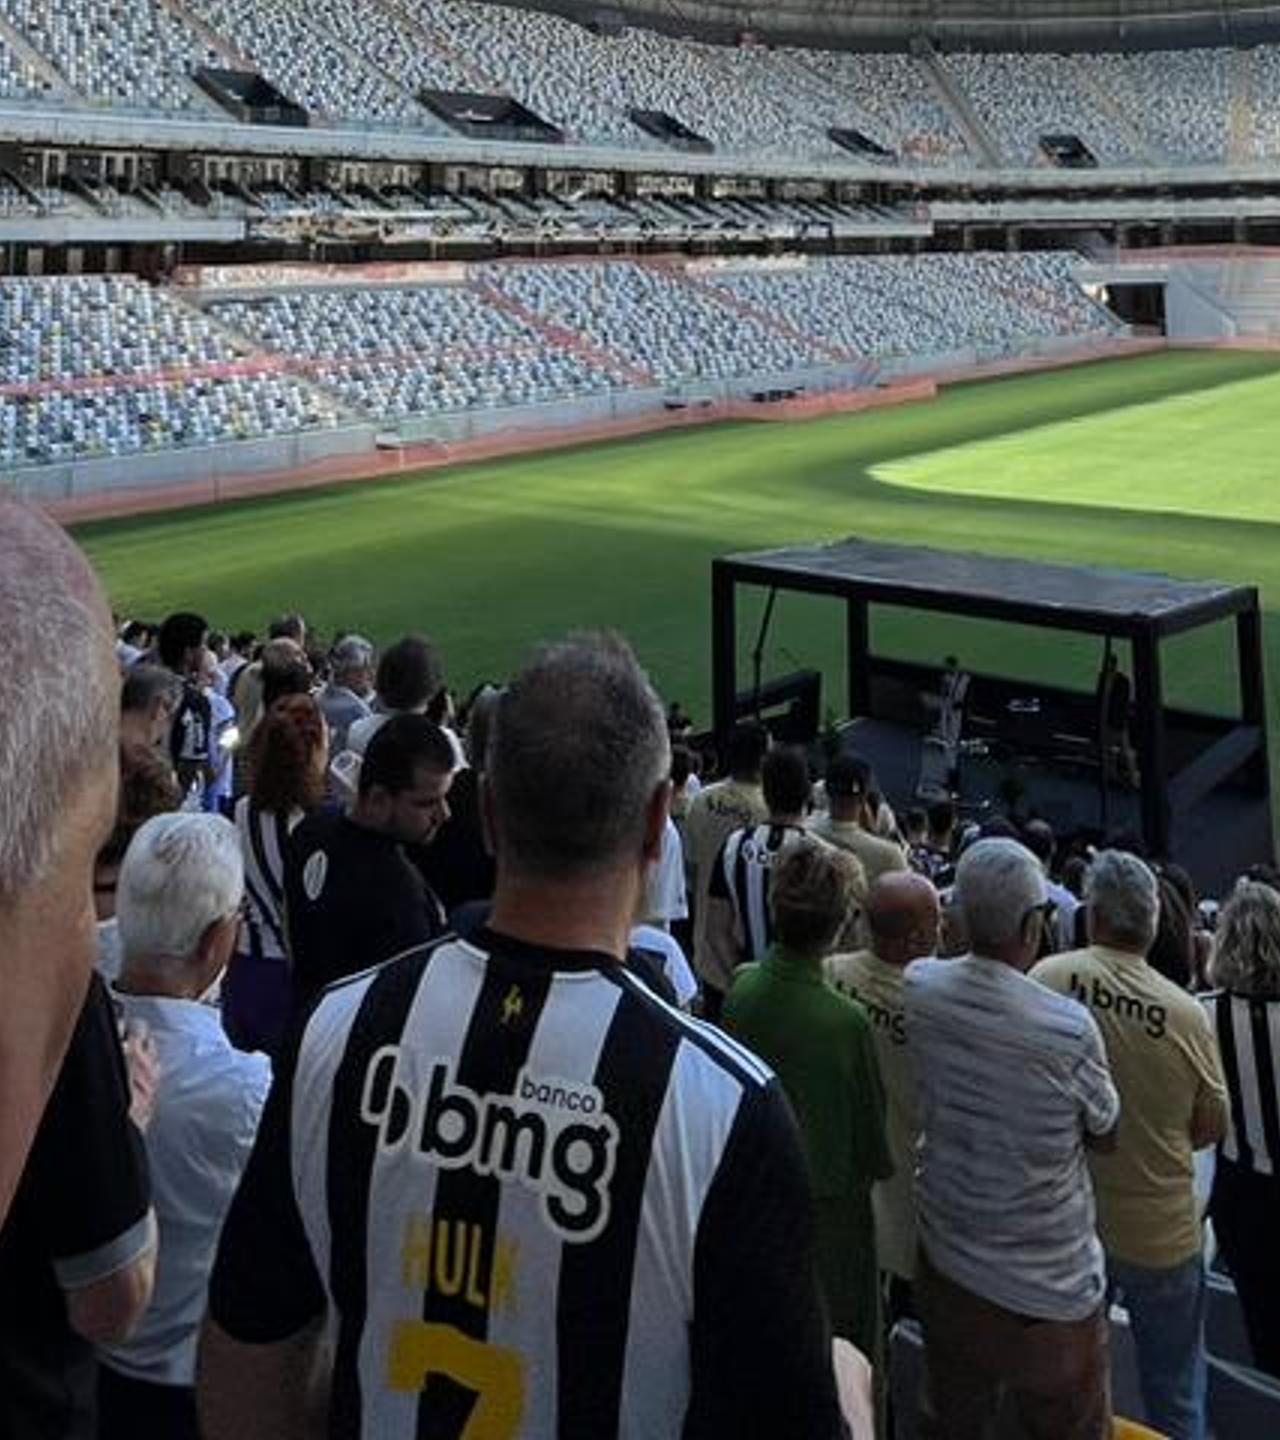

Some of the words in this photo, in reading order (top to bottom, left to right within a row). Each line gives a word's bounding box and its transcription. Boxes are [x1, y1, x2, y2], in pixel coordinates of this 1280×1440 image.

[1091, 976, 1167, 1039] bmg
[519, 1077, 598, 1114] banco
[419, 1062, 613, 1232] bmg
[387, 1319, 527, 1440] 7
